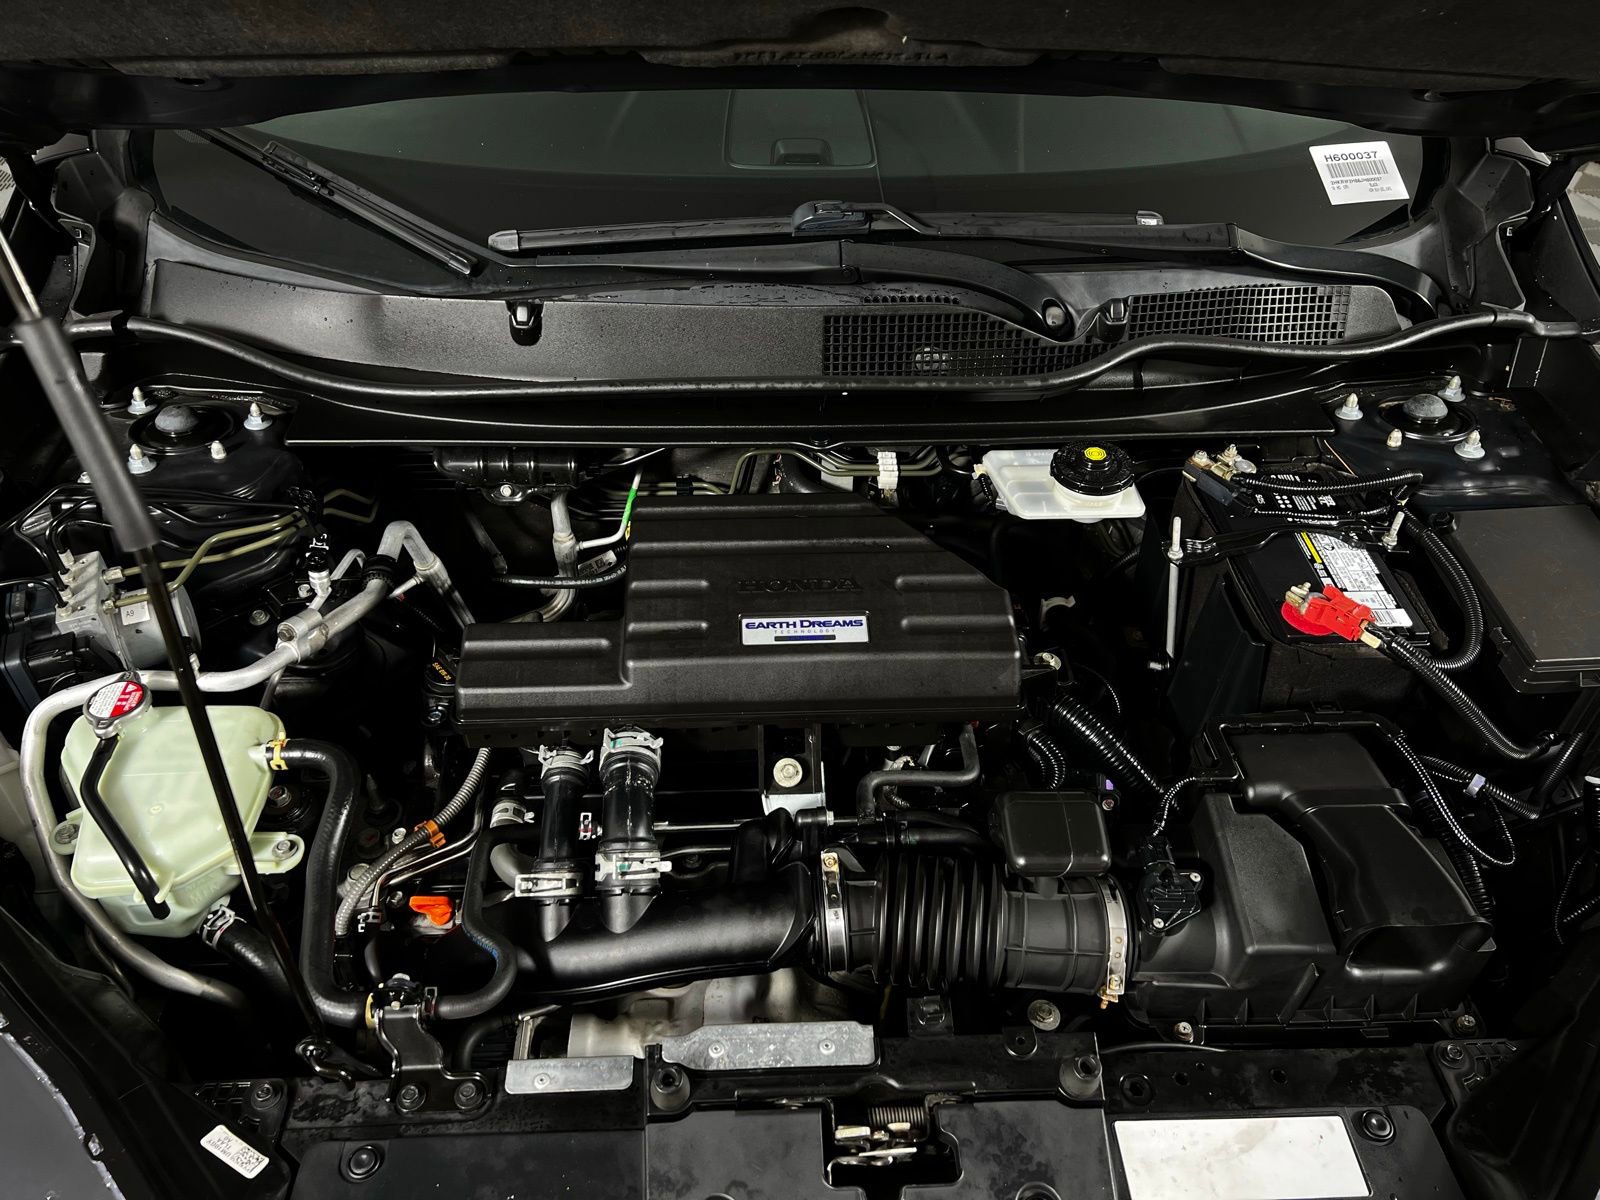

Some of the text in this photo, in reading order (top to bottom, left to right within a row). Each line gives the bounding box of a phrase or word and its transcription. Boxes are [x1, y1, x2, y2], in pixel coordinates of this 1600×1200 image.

[1324, 151, 1378, 162] H600037
[737, 578, 863, 592] HONDA
[745, 619, 863, 630] EARTH DREAMS
